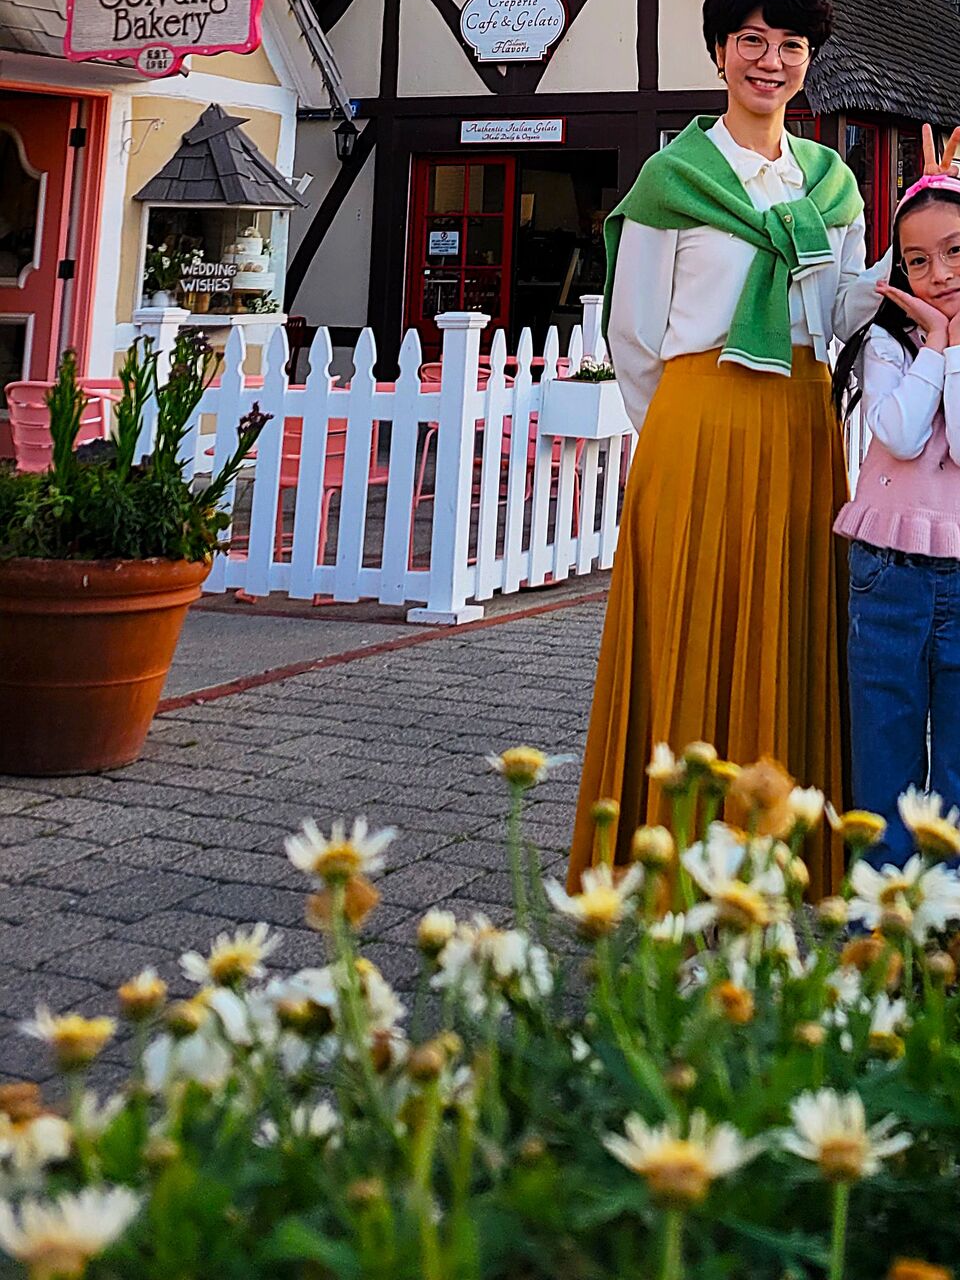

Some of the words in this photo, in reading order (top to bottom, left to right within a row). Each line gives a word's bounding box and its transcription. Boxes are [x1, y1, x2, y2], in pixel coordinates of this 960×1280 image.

[112, 7, 211, 44] Bakery
[466, 10, 499, 34] Cafe
[501, 16, 511, 27] &
[512, 8, 559, 32] Gelato
[147, 49, 168, 59] EST
[491, 39, 530, 54] Flavors
[466, 122, 503, 133] Authentic
[505, 122, 532, 132] Italian
[533, 121, 558, 133] Gelato
[181, 262, 238, 277] WEDDING
[180, 278, 231, 293] WISHES
